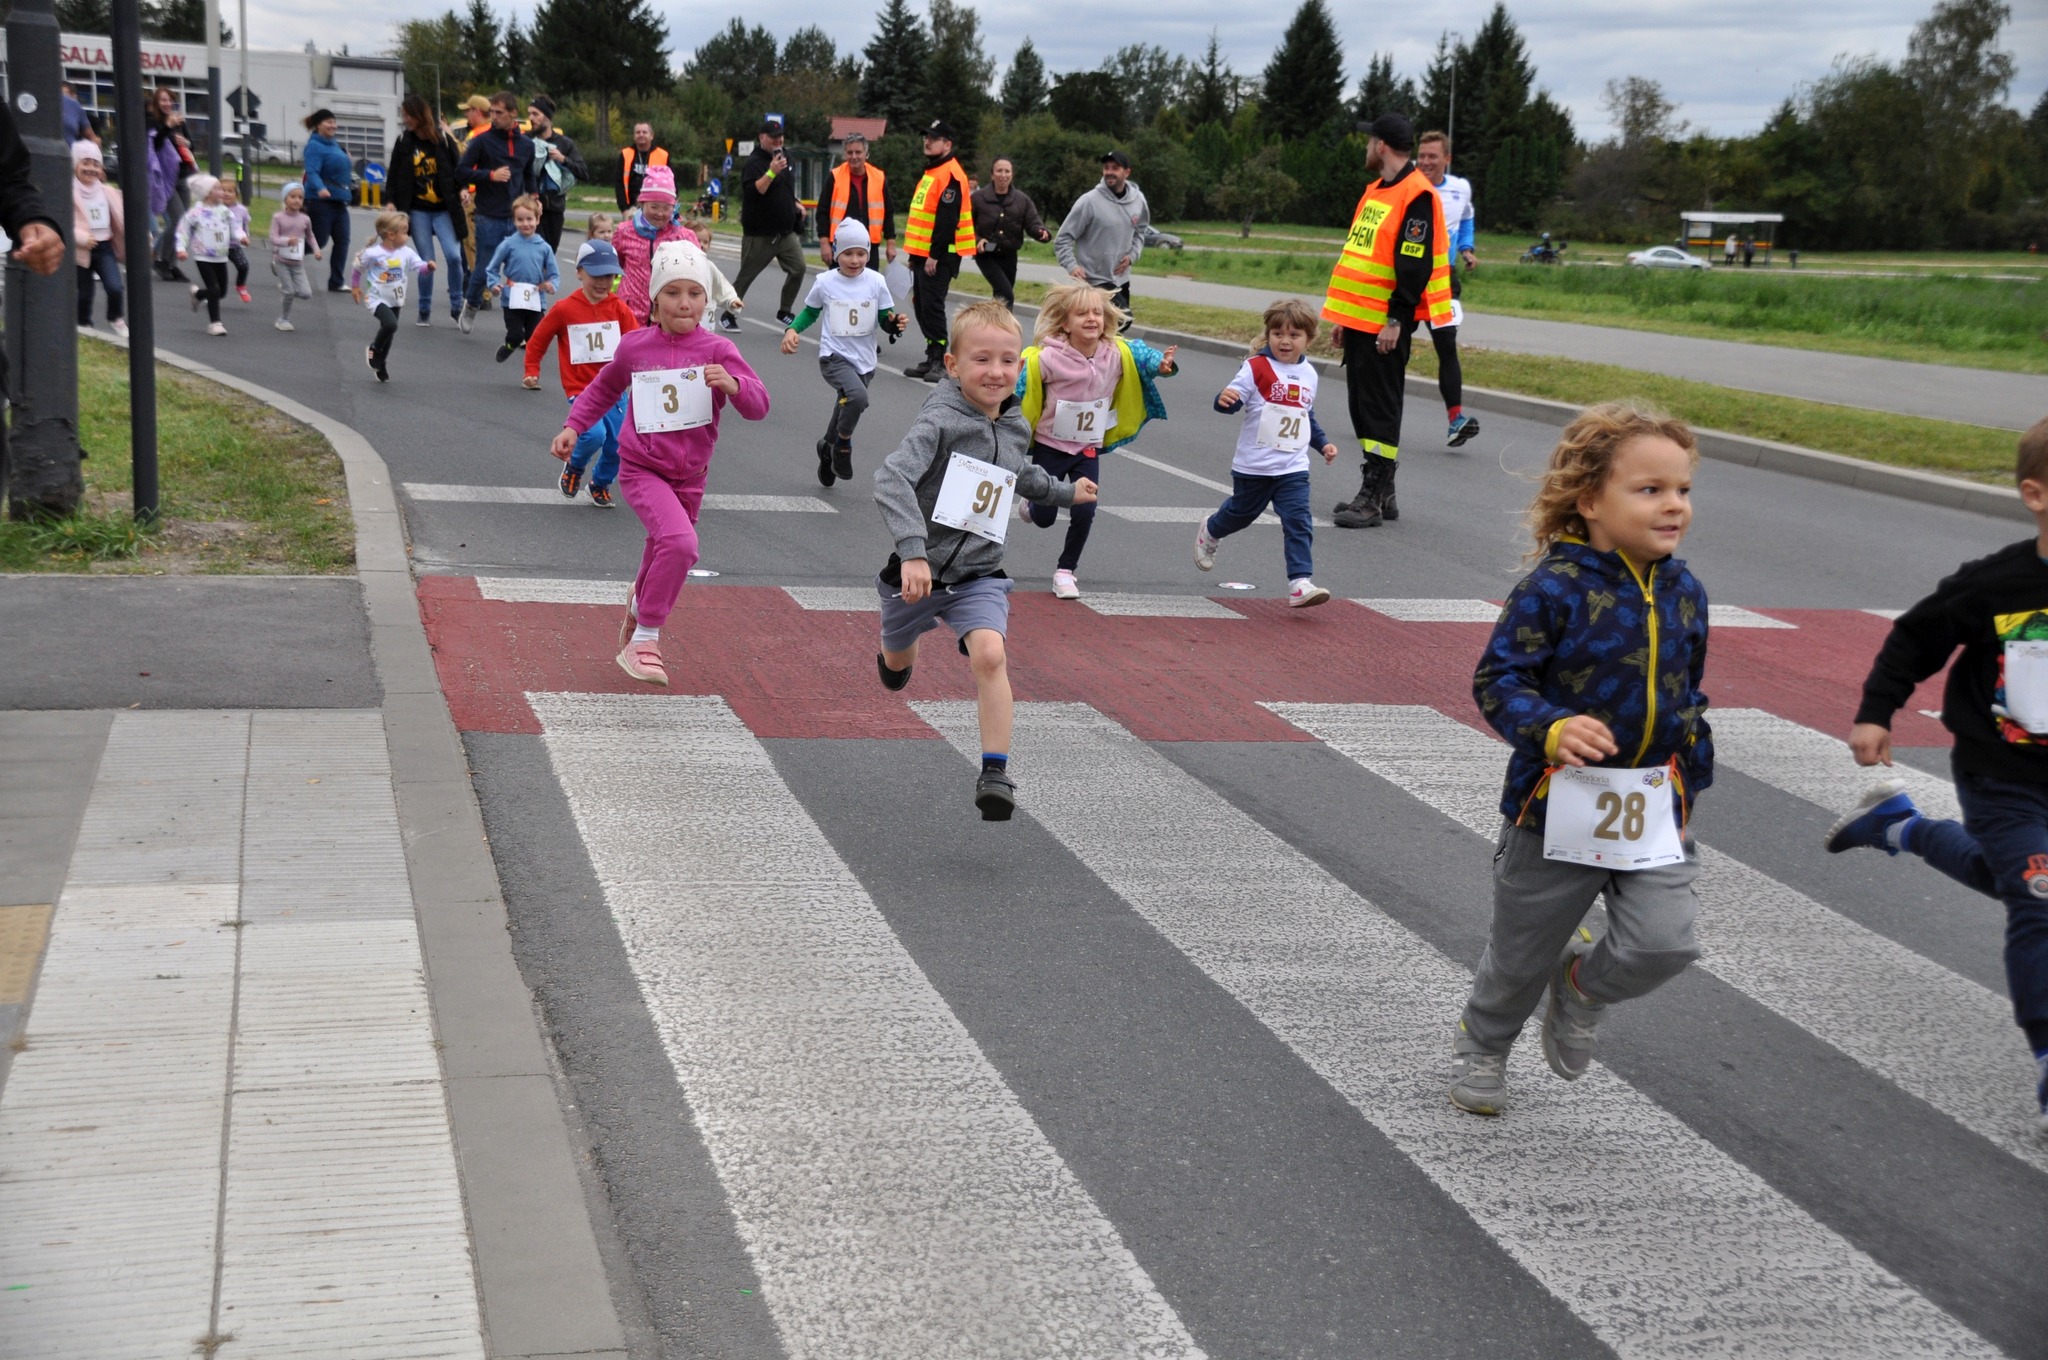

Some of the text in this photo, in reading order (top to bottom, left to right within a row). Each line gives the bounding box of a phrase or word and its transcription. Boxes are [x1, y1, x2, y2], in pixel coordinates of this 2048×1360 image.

[61, 45, 186, 72] SALA BAW
[1346, 225, 1374, 249] HEM
[1404, 244, 1421, 255] OSP
[393, 286, 404, 299] 19
[523, 289, 531, 301] 9
[849, 308, 858, 326] 6
[586, 331, 605, 351] 14
[662, 384, 679, 414] 3
[1076, 411, 1095, 431] 12
[1278, 416, 1301, 440] 24
[972, 480, 1003, 519] 91
[1564, 768, 1610, 784] Mandoria
[1593, 791, 1646, 842] 28
